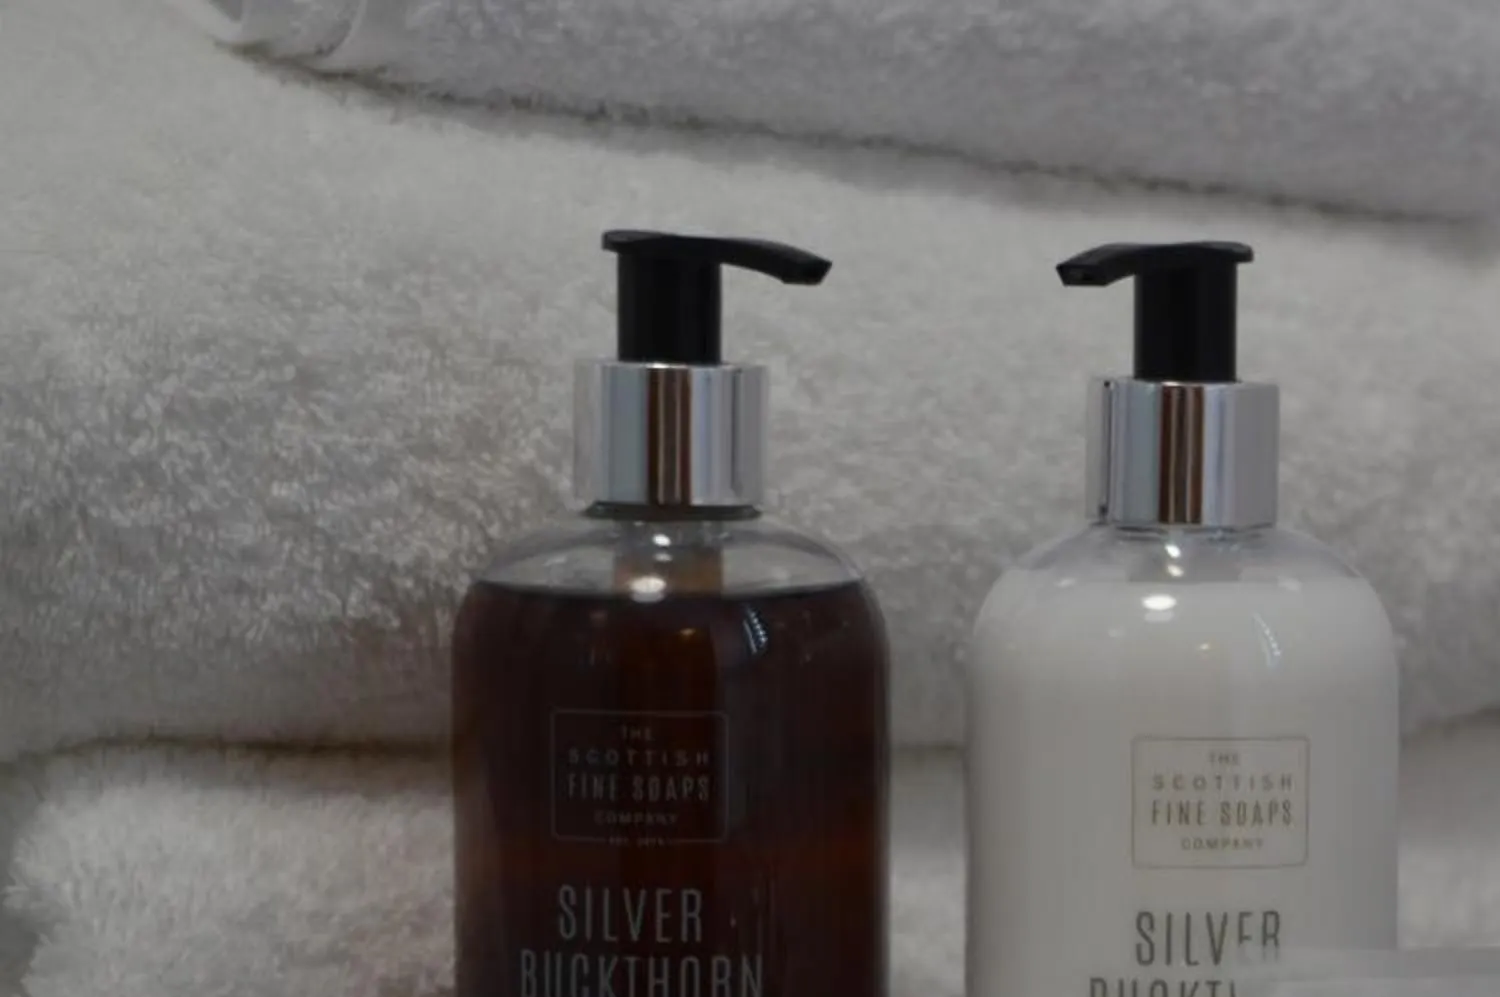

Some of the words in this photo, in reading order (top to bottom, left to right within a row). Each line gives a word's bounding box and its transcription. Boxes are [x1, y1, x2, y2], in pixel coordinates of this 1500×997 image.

[567, 748, 710, 767] SCOTTISH
[1209, 751, 1240, 766] THE
[567, 773, 618, 801] FINE
[631, 774, 711, 803] SOAPS
[1152, 774, 1294, 791] SCOTTISH
[594, 809, 679, 826] COMPANY
[1151, 799, 1206, 826] FINE
[1219, 800, 1294, 826] SOAPS
[1181, 837, 1264, 851] COMPANY
[558, 883, 704, 943] SILVER
[1135, 909, 1282, 967] SILVER
